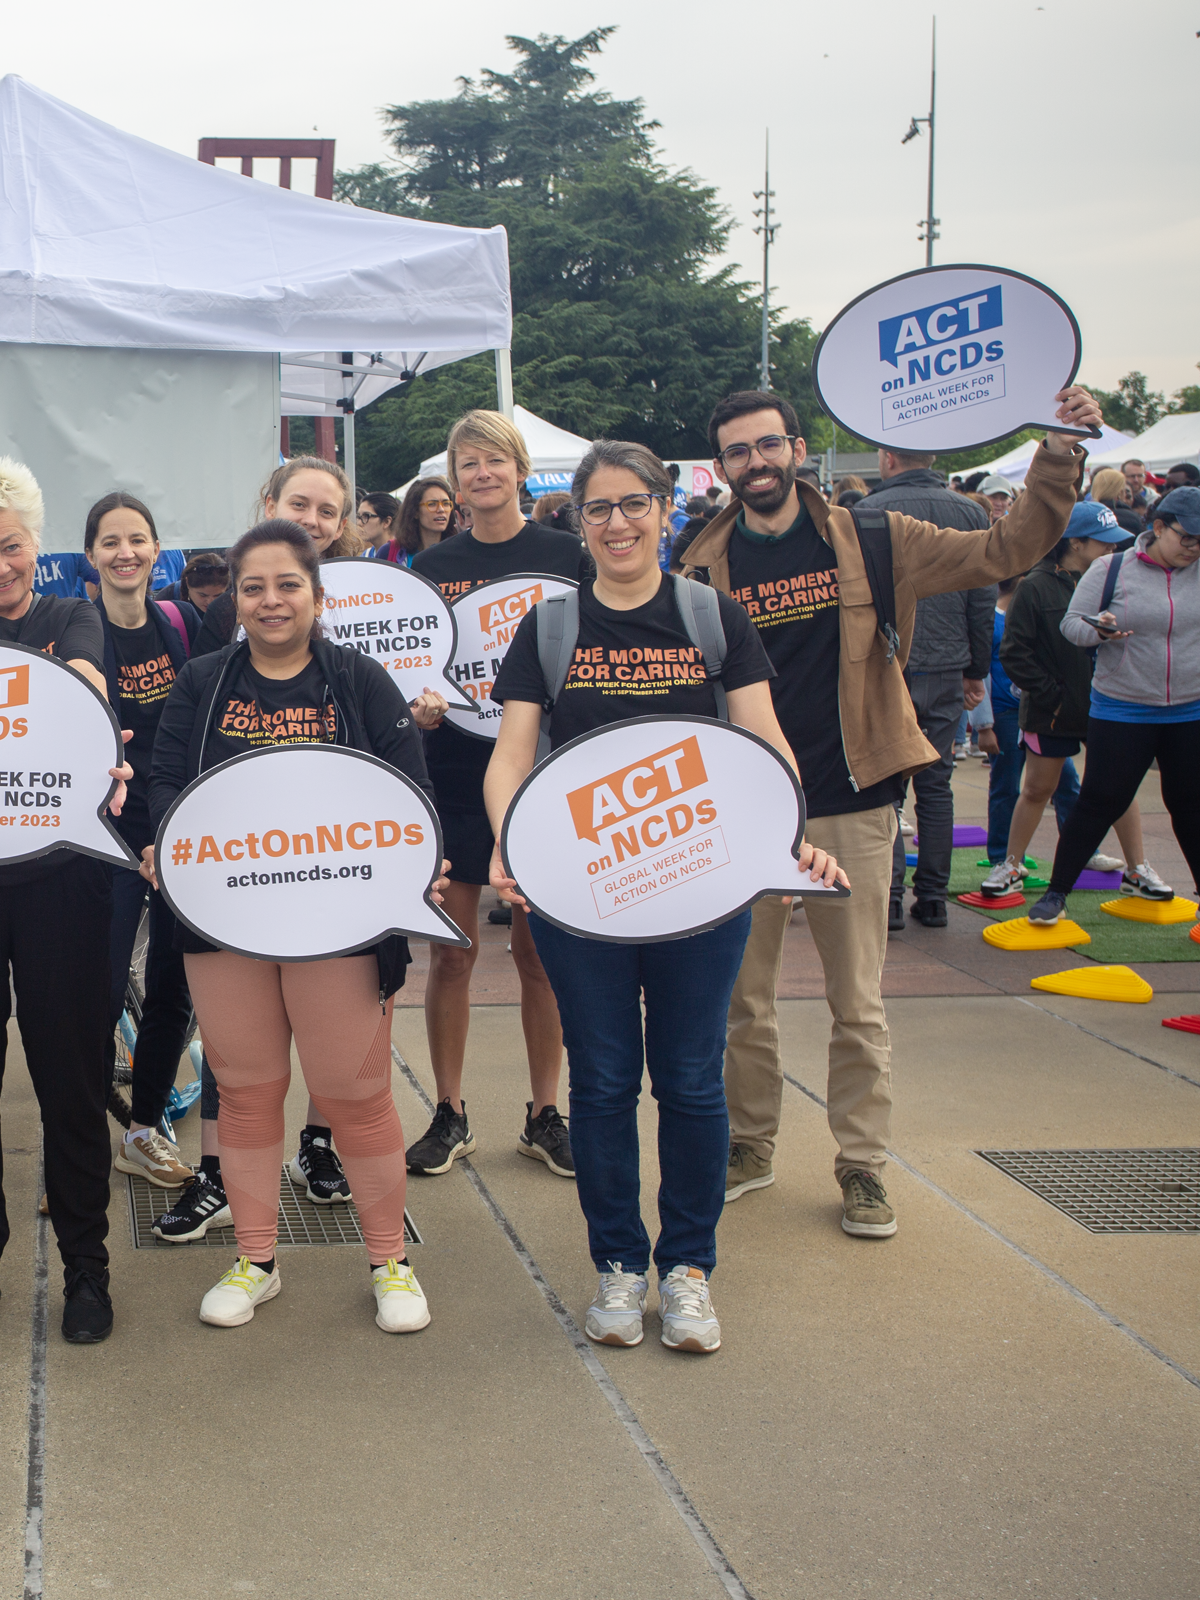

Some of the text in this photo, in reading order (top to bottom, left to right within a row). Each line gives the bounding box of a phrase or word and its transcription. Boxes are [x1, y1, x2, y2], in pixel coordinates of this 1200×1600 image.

[894, 294, 987, 353] ACT
[881, 340, 1004, 392] on NCDs
[892, 374, 994, 410] GLOBAL WEEK FOR
[898, 389, 990, 421] ACTION ON NCDs
[33, 561, 63, 586] ALK
[439, 581, 471, 594] THE
[730, 586, 753, 602] HE
[324, 592, 394, 610] OnNCDs
[489, 589, 536, 627] ACT
[751, 602, 826, 623] WEEK FOR ACTION ON
[770, 616, 800, 626] SEPTEMBER
[334, 615, 438, 639] WEEK FOR
[376, 636, 431, 653] NCDs
[484, 642, 496, 651] on
[394, 655, 432, 670] 2023
[575, 647, 603, 663] HE
[140, 667, 176, 690] CARI
[450, 661, 486, 682] HE
[567, 664, 706, 681] FOR CARING
[462, 681, 494, 700] OR
[565, 681, 594, 690] GLOBAL
[640, 680, 672, 689] ACTION
[227, 700, 256, 716] THE
[222, 714, 259, 731] FOR
[29, 772, 71, 788] FOR
[592, 748, 684, 828] ACT
[5, 791, 62, 807] NCDs
[20, 814, 60, 827] 2023
[172, 819, 424, 866] #ActOnNCDs
[587, 799, 717, 876] on NCDs
[227, 864, 372, 888] actonncds.org
[604, 838, 713, 894] GLOBAL WEEK FOR
[614, 856, 712, 906] ACTION ON NCDs
